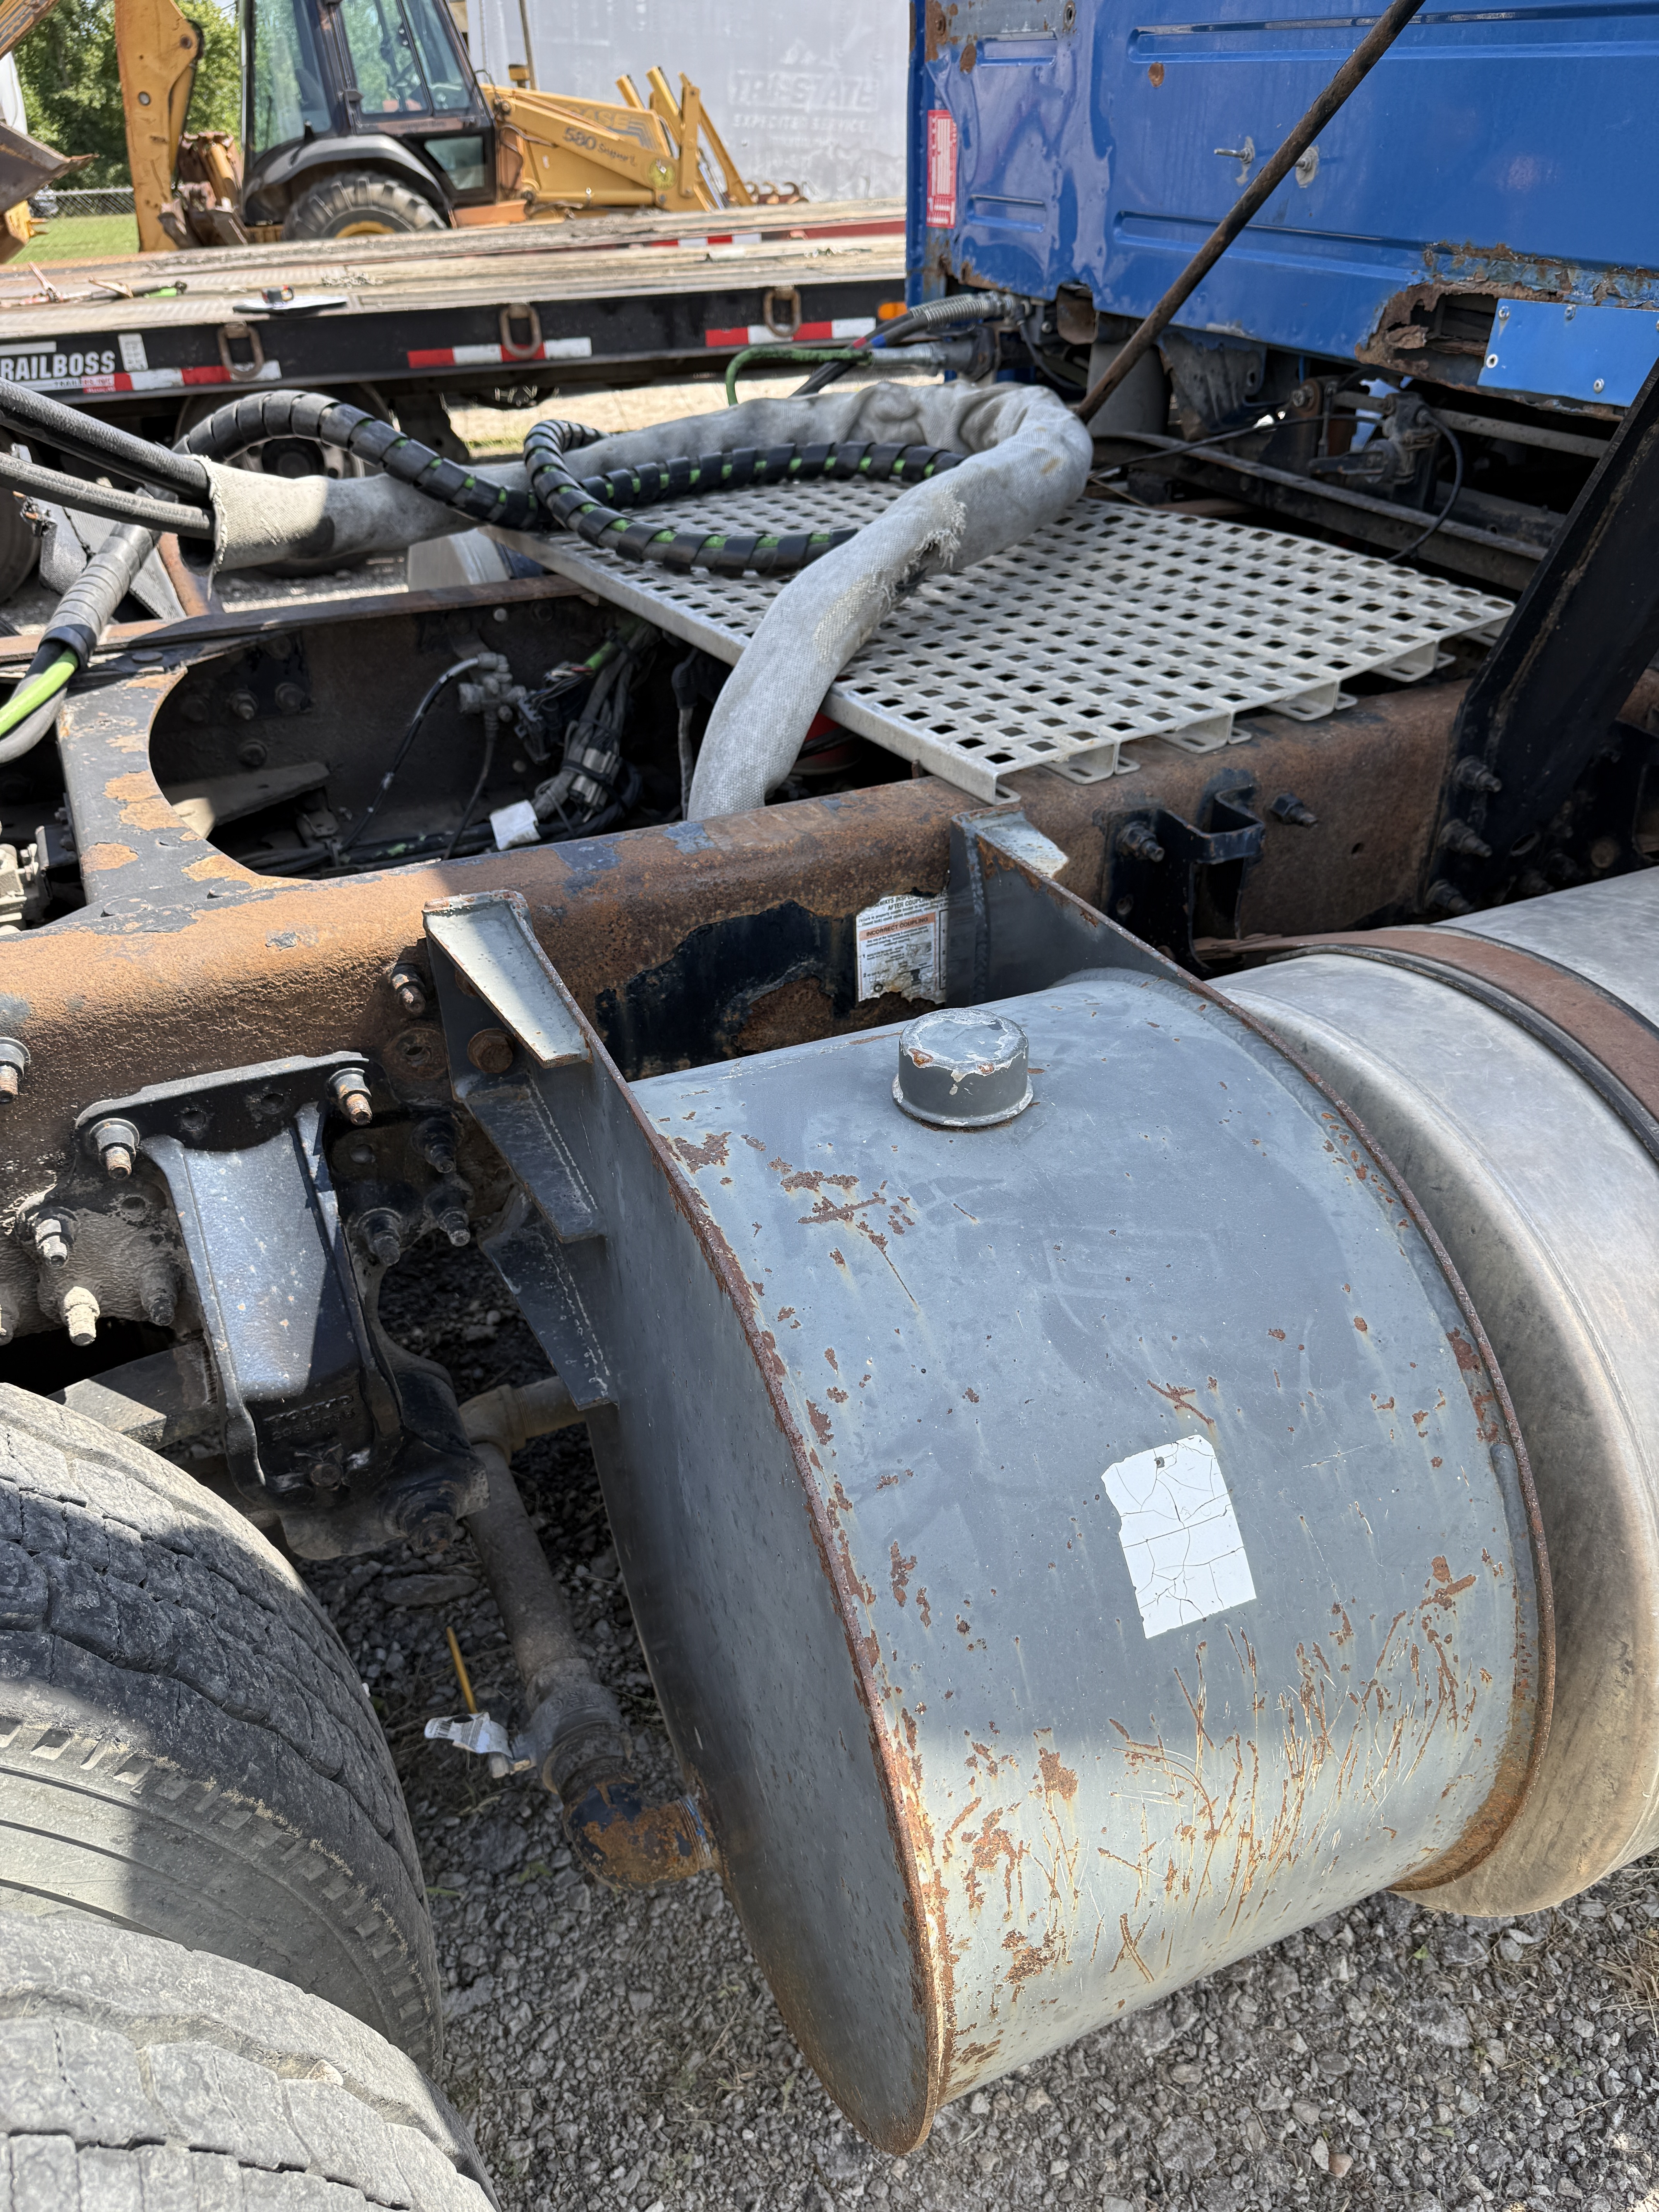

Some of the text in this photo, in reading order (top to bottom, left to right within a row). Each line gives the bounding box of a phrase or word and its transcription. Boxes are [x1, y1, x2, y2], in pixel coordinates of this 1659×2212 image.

[562, 126, 597, 151] 580
[888, 902, 903, 911] AFTER
[866, 924, 898, 936] INCORRECT
[899, 917, 928, 929] COUPLING
